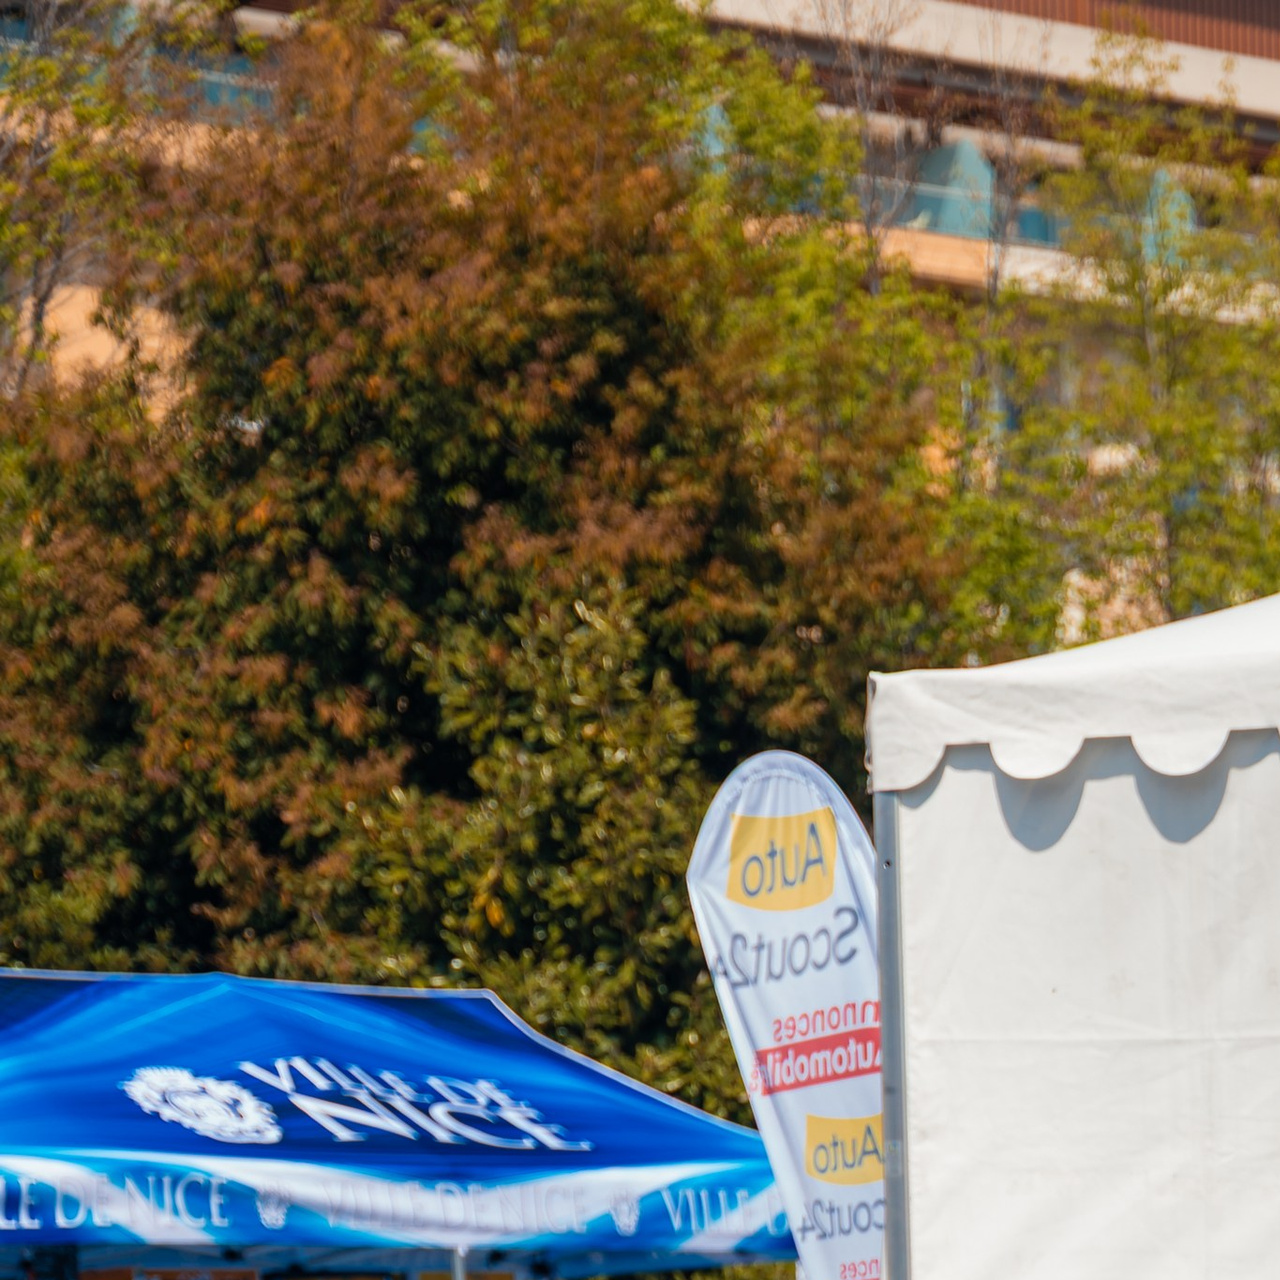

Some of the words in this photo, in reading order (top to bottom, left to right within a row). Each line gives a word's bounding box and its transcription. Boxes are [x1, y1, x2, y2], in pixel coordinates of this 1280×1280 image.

[236, 1055, 432, 1103] VILLE
[287, 1088, 594, 1151] NICE
[54, 1173, 113, 1229] DE
[125, 1172, 230, 1229] NICE
[661, 1187, 750, 1232] VILLE
